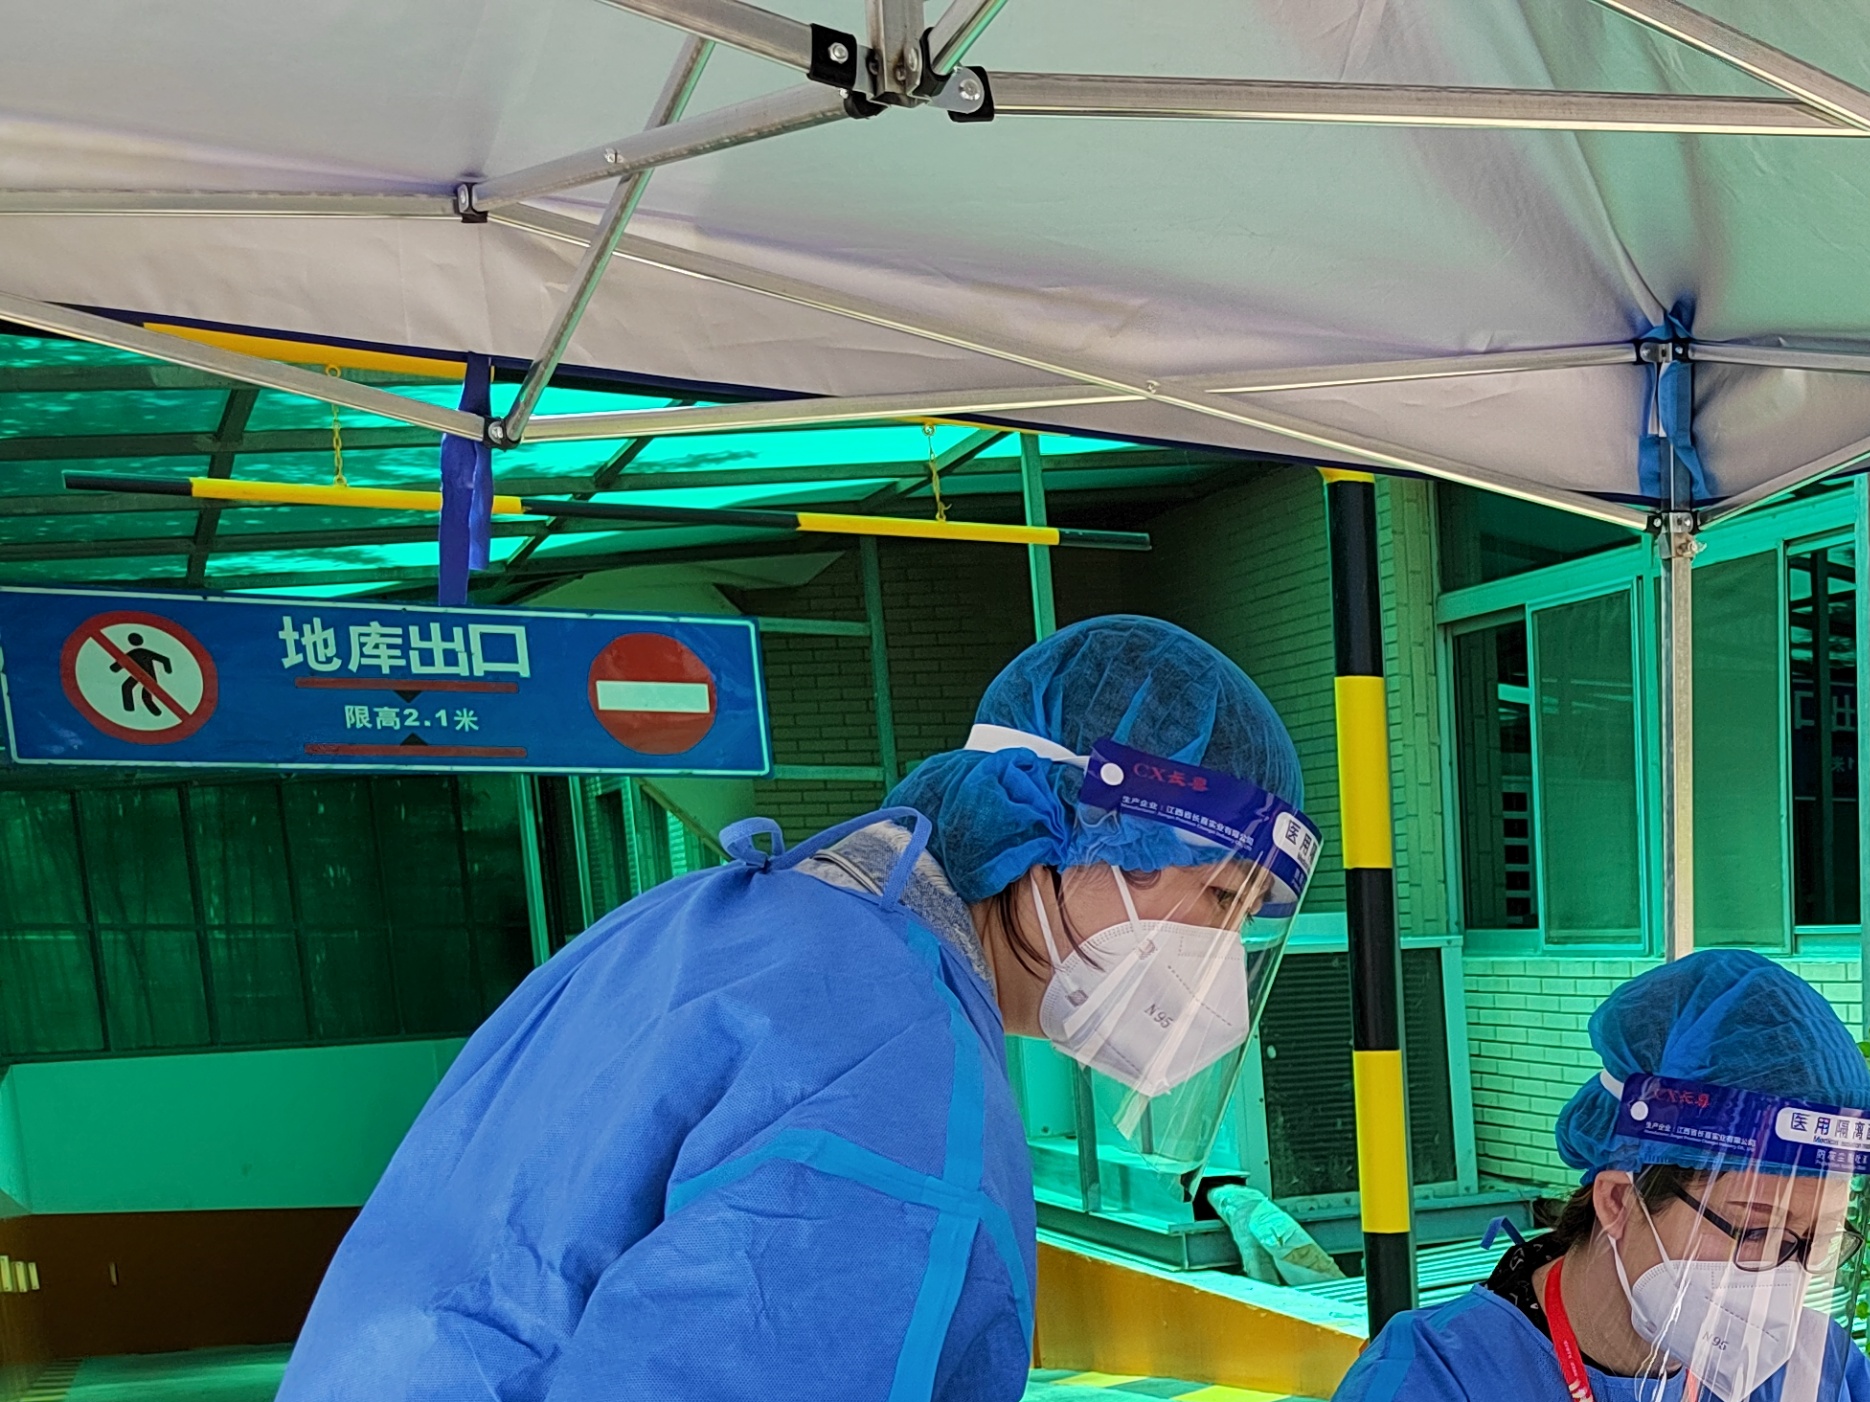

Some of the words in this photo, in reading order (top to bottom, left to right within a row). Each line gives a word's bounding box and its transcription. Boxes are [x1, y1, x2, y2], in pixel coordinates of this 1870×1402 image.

[278, 615, 531, 678] 地库出口
[344, 704, 480, 732] 限高2.1米
[1143, 1003, 1174, 1029] N95
[1702, 1331, 1730, 1351] N95
